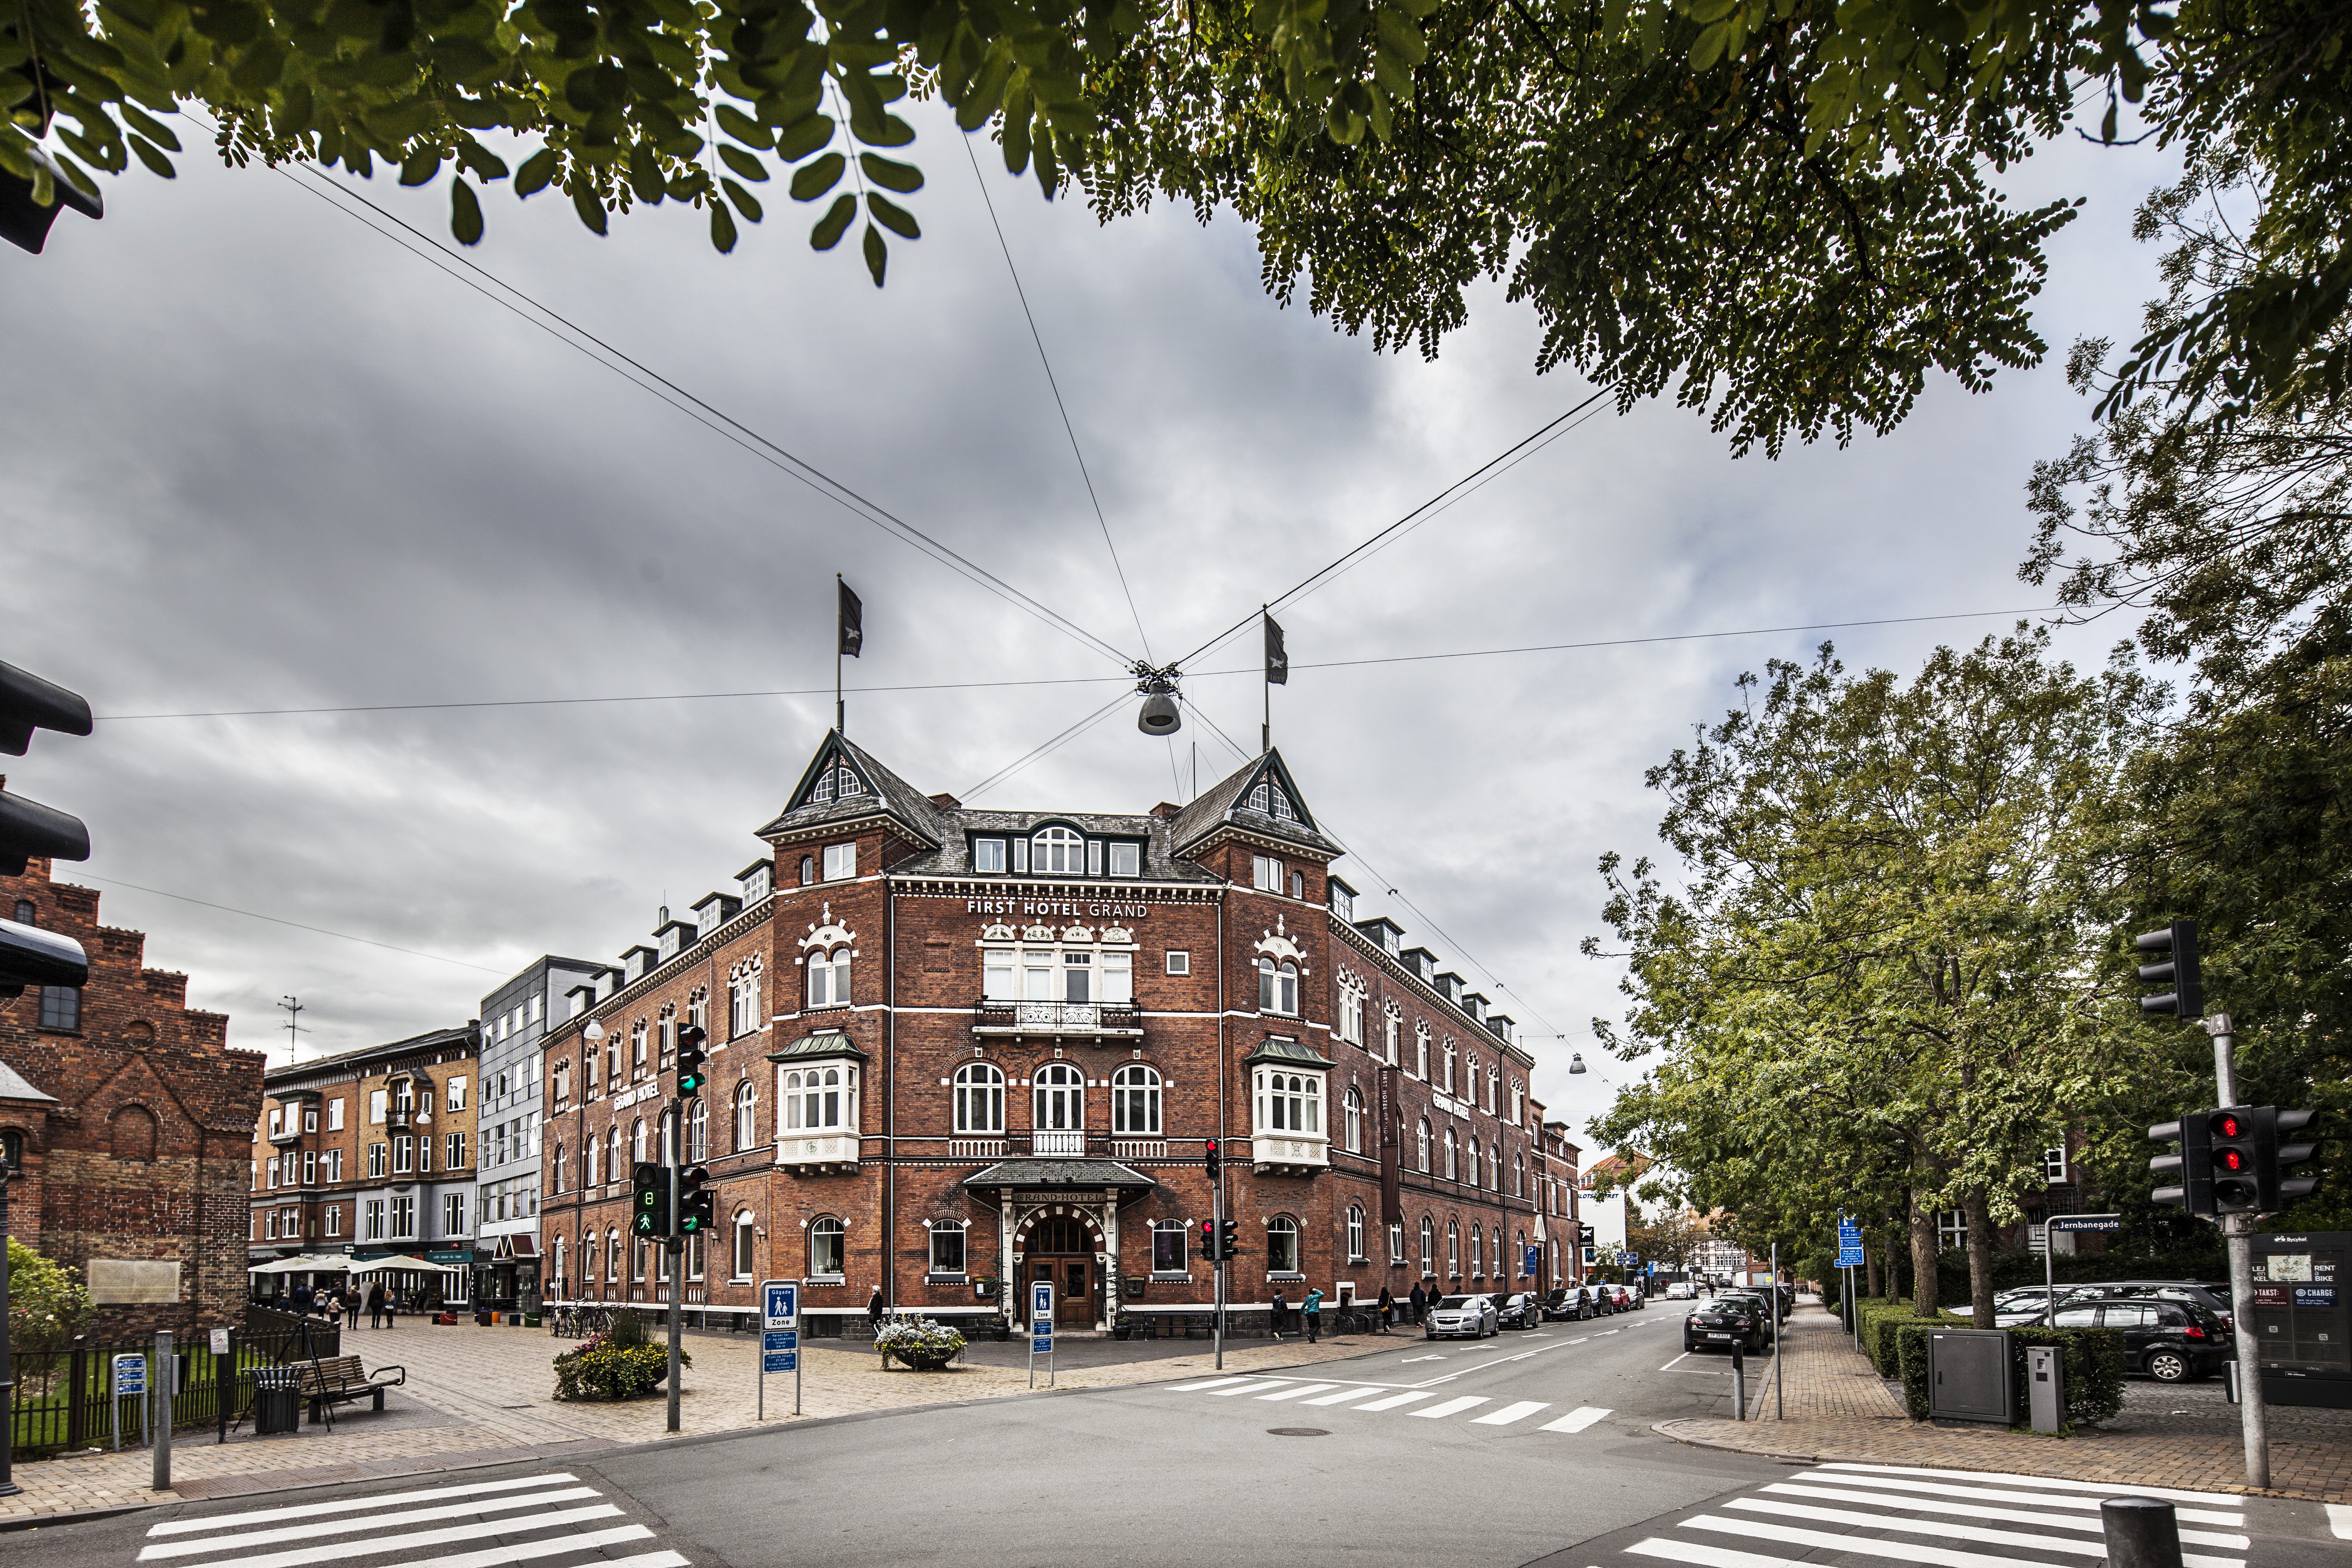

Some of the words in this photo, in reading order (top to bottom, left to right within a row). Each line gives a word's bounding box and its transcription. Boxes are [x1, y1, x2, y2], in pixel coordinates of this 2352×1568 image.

[967, 900, 1016, 913] FIRST
[1024, 902, 1081, 916] HOTEL
[1089, 904, 1147, 917] GRAND
[614, 1090, 637, 1111] GRAND
[637, 1081, 660, 1103] HOTEL
[1433, 1093, 1453, 1113] GRAND
[1453, 1102, 1470, 1121] HOTEL
[645, 1192, 653, 1204] 8
[2060, 1220, 2119, 1230] Jernbanegade
[1528, 1247, 1534, 1255] P
